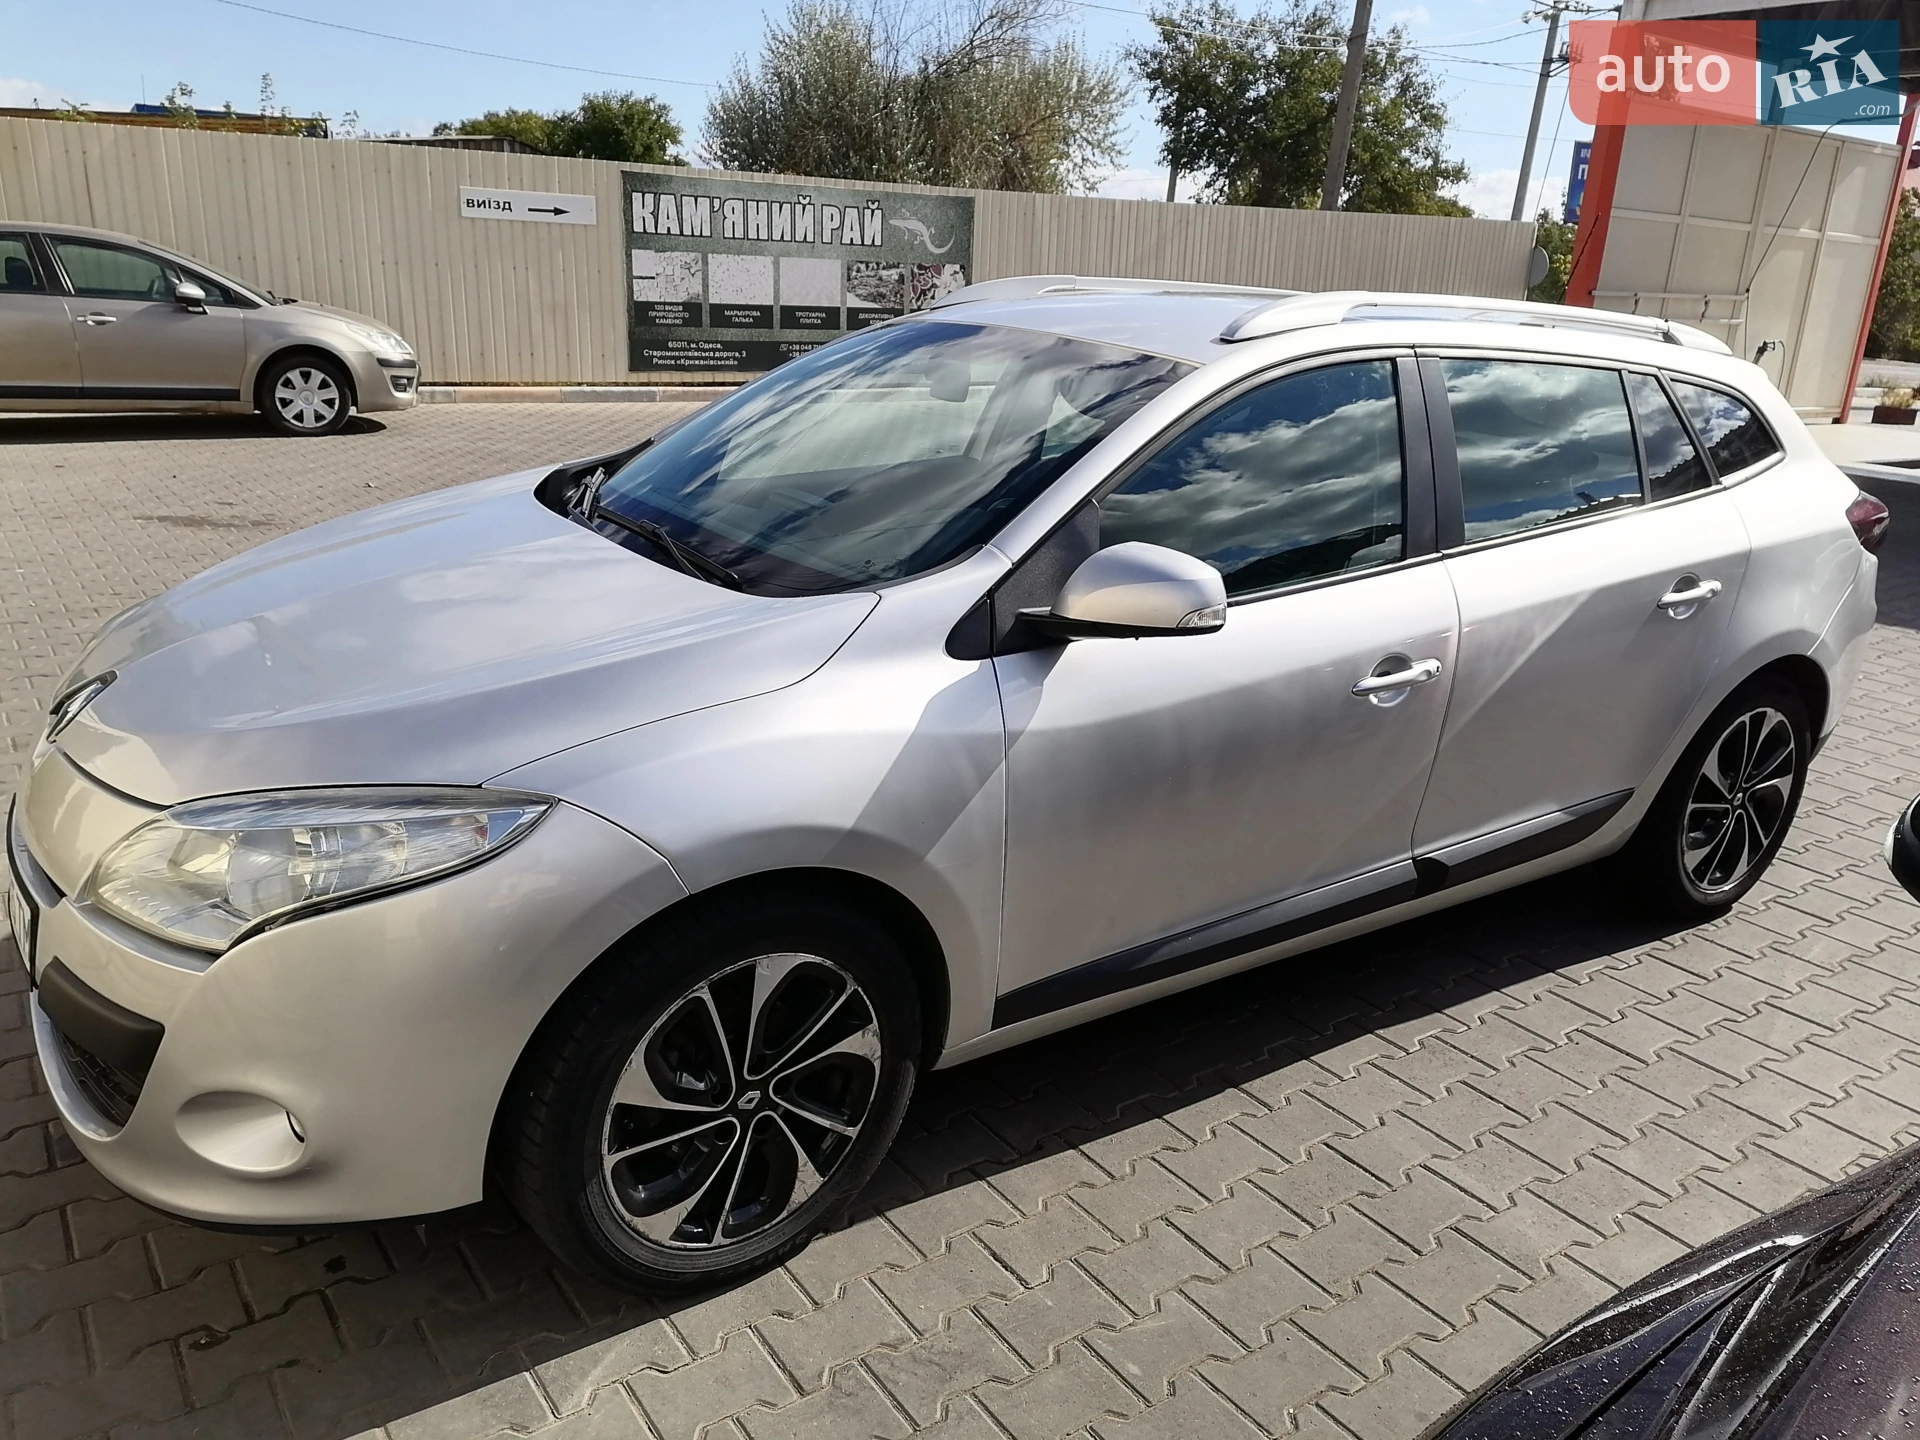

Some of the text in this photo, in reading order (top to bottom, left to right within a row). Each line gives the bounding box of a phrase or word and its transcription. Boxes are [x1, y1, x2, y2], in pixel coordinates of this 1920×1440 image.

[821, 199, 883, 247] РАЙ
[698, 341, 722, 350] Одеса,
[644, 349, 714, 358] Старомиколаївська
[714, 350, 740, 359] дорога,
